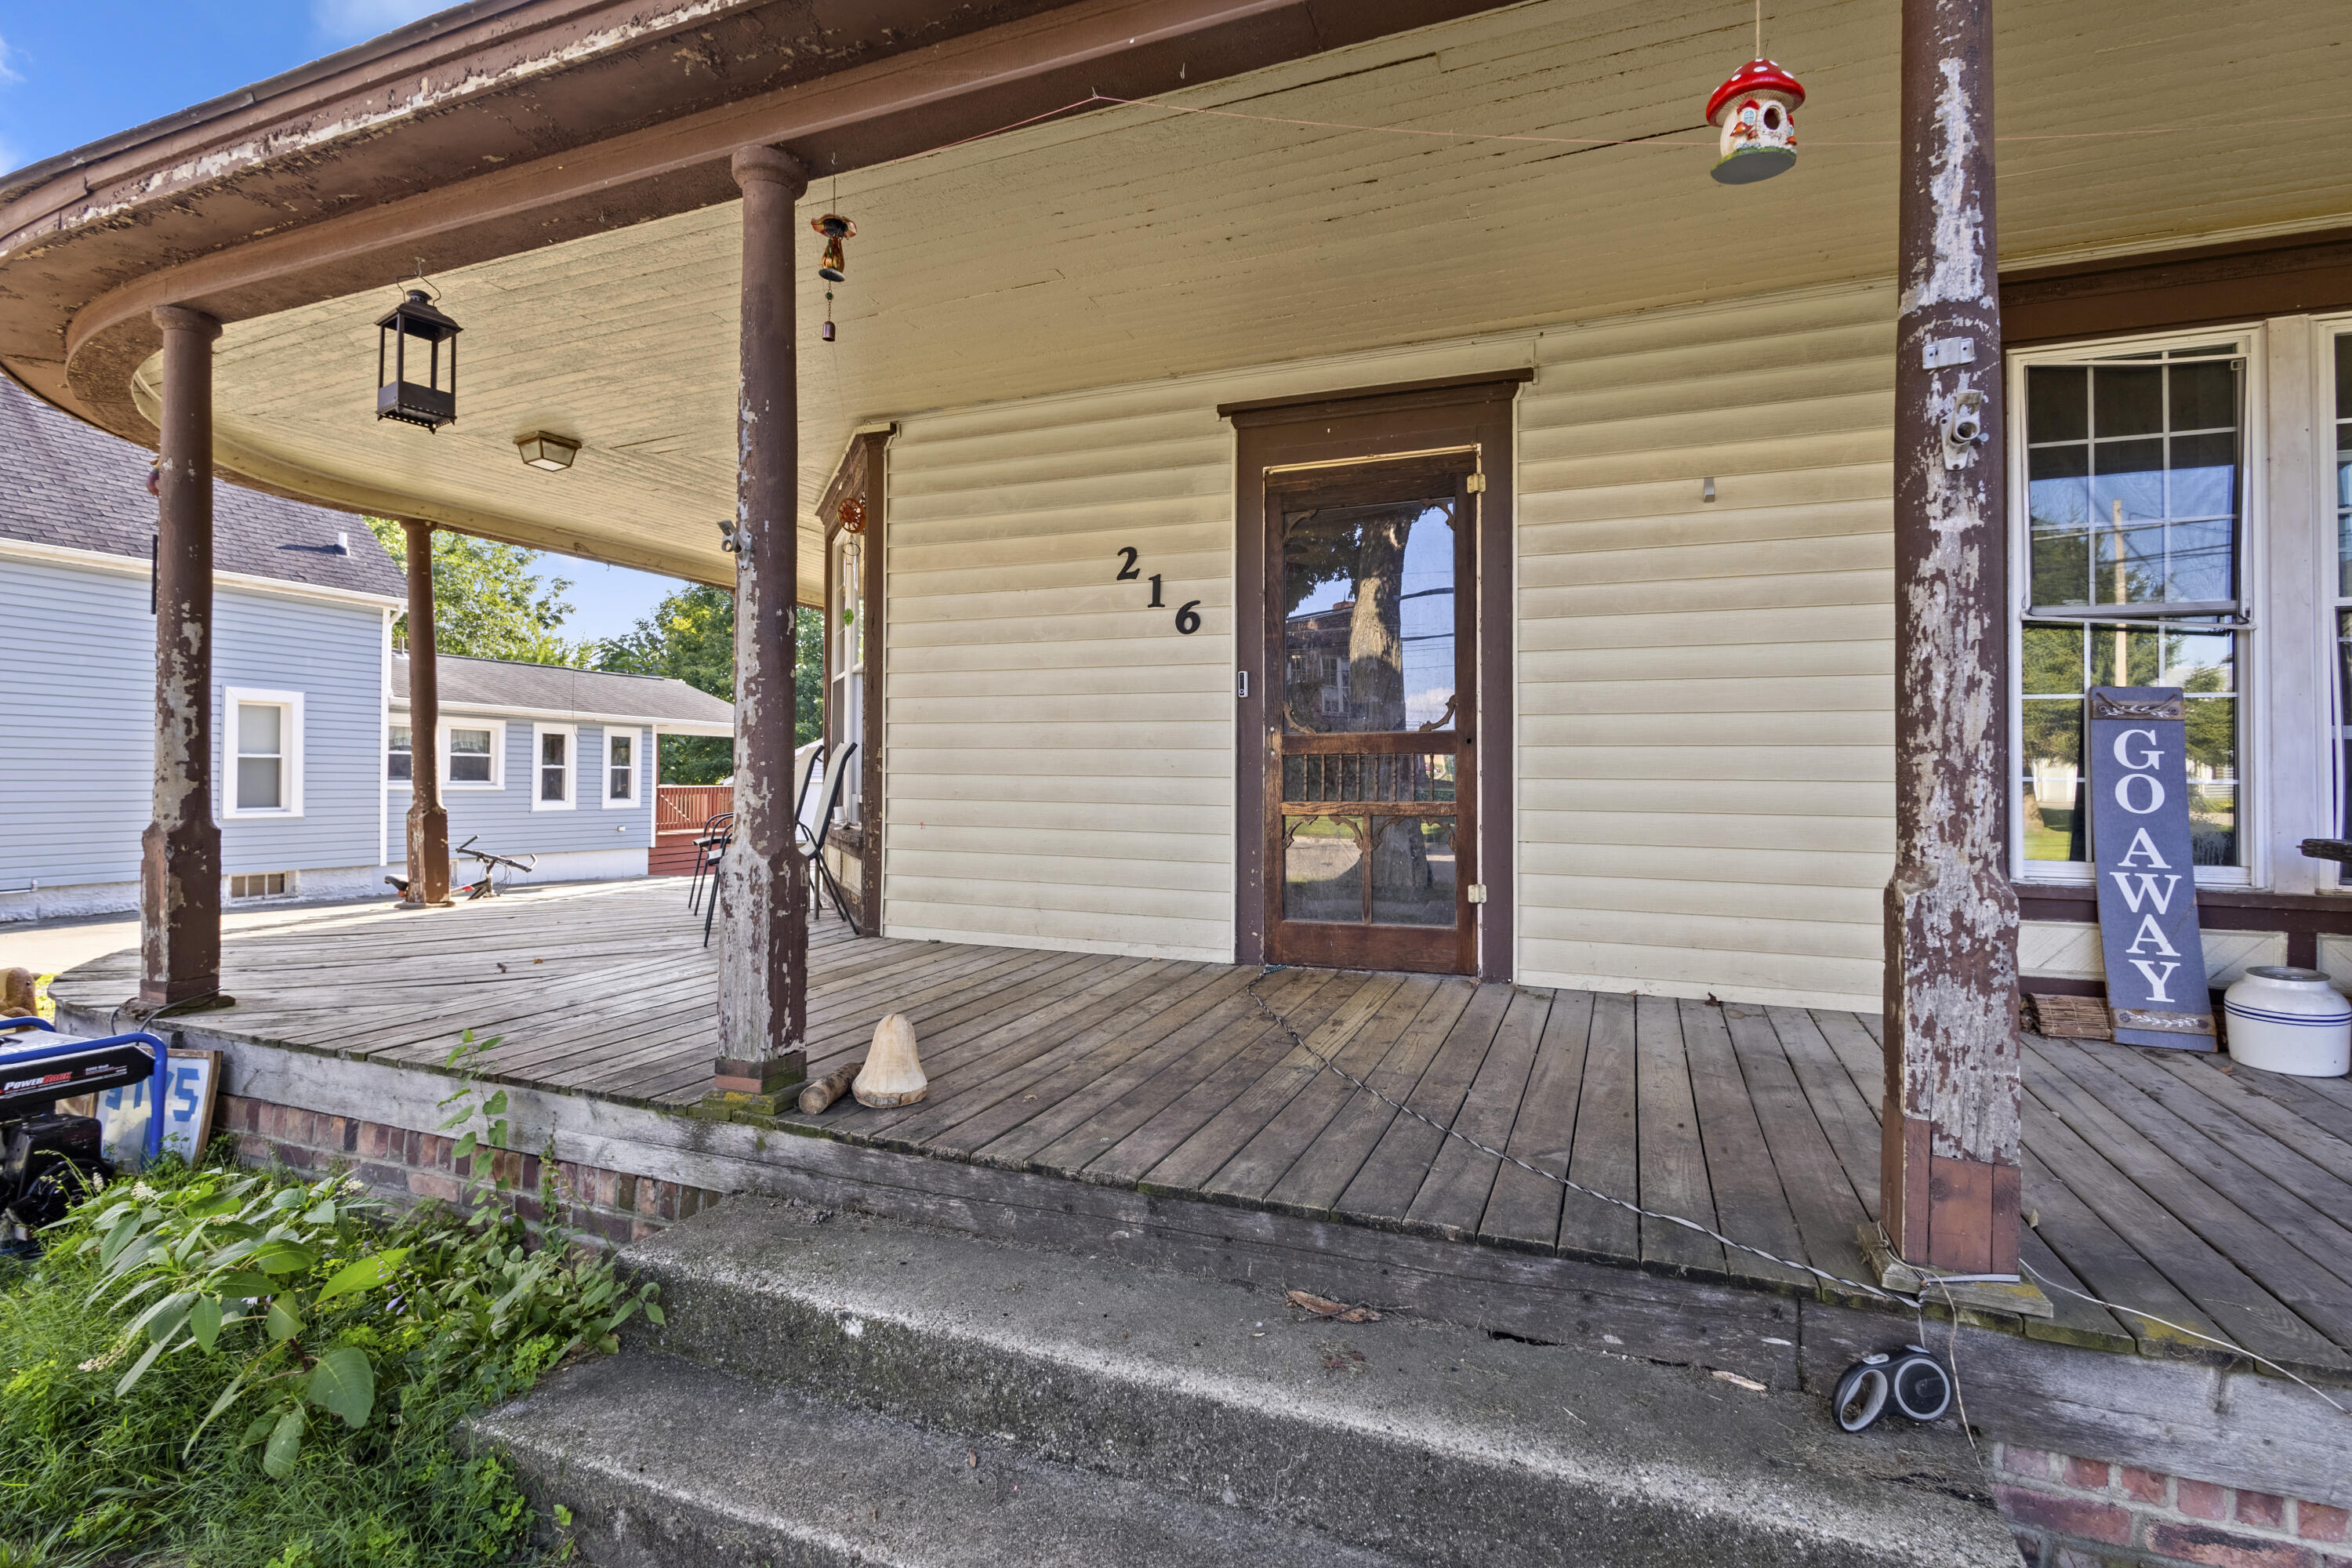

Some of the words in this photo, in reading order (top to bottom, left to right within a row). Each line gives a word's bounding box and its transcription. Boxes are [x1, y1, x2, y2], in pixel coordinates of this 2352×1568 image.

[1116, 546, 1201, 635] 216
[2113, 729, 2165, 815] GO
[2110, 827, 2182, 1003] AWAY
